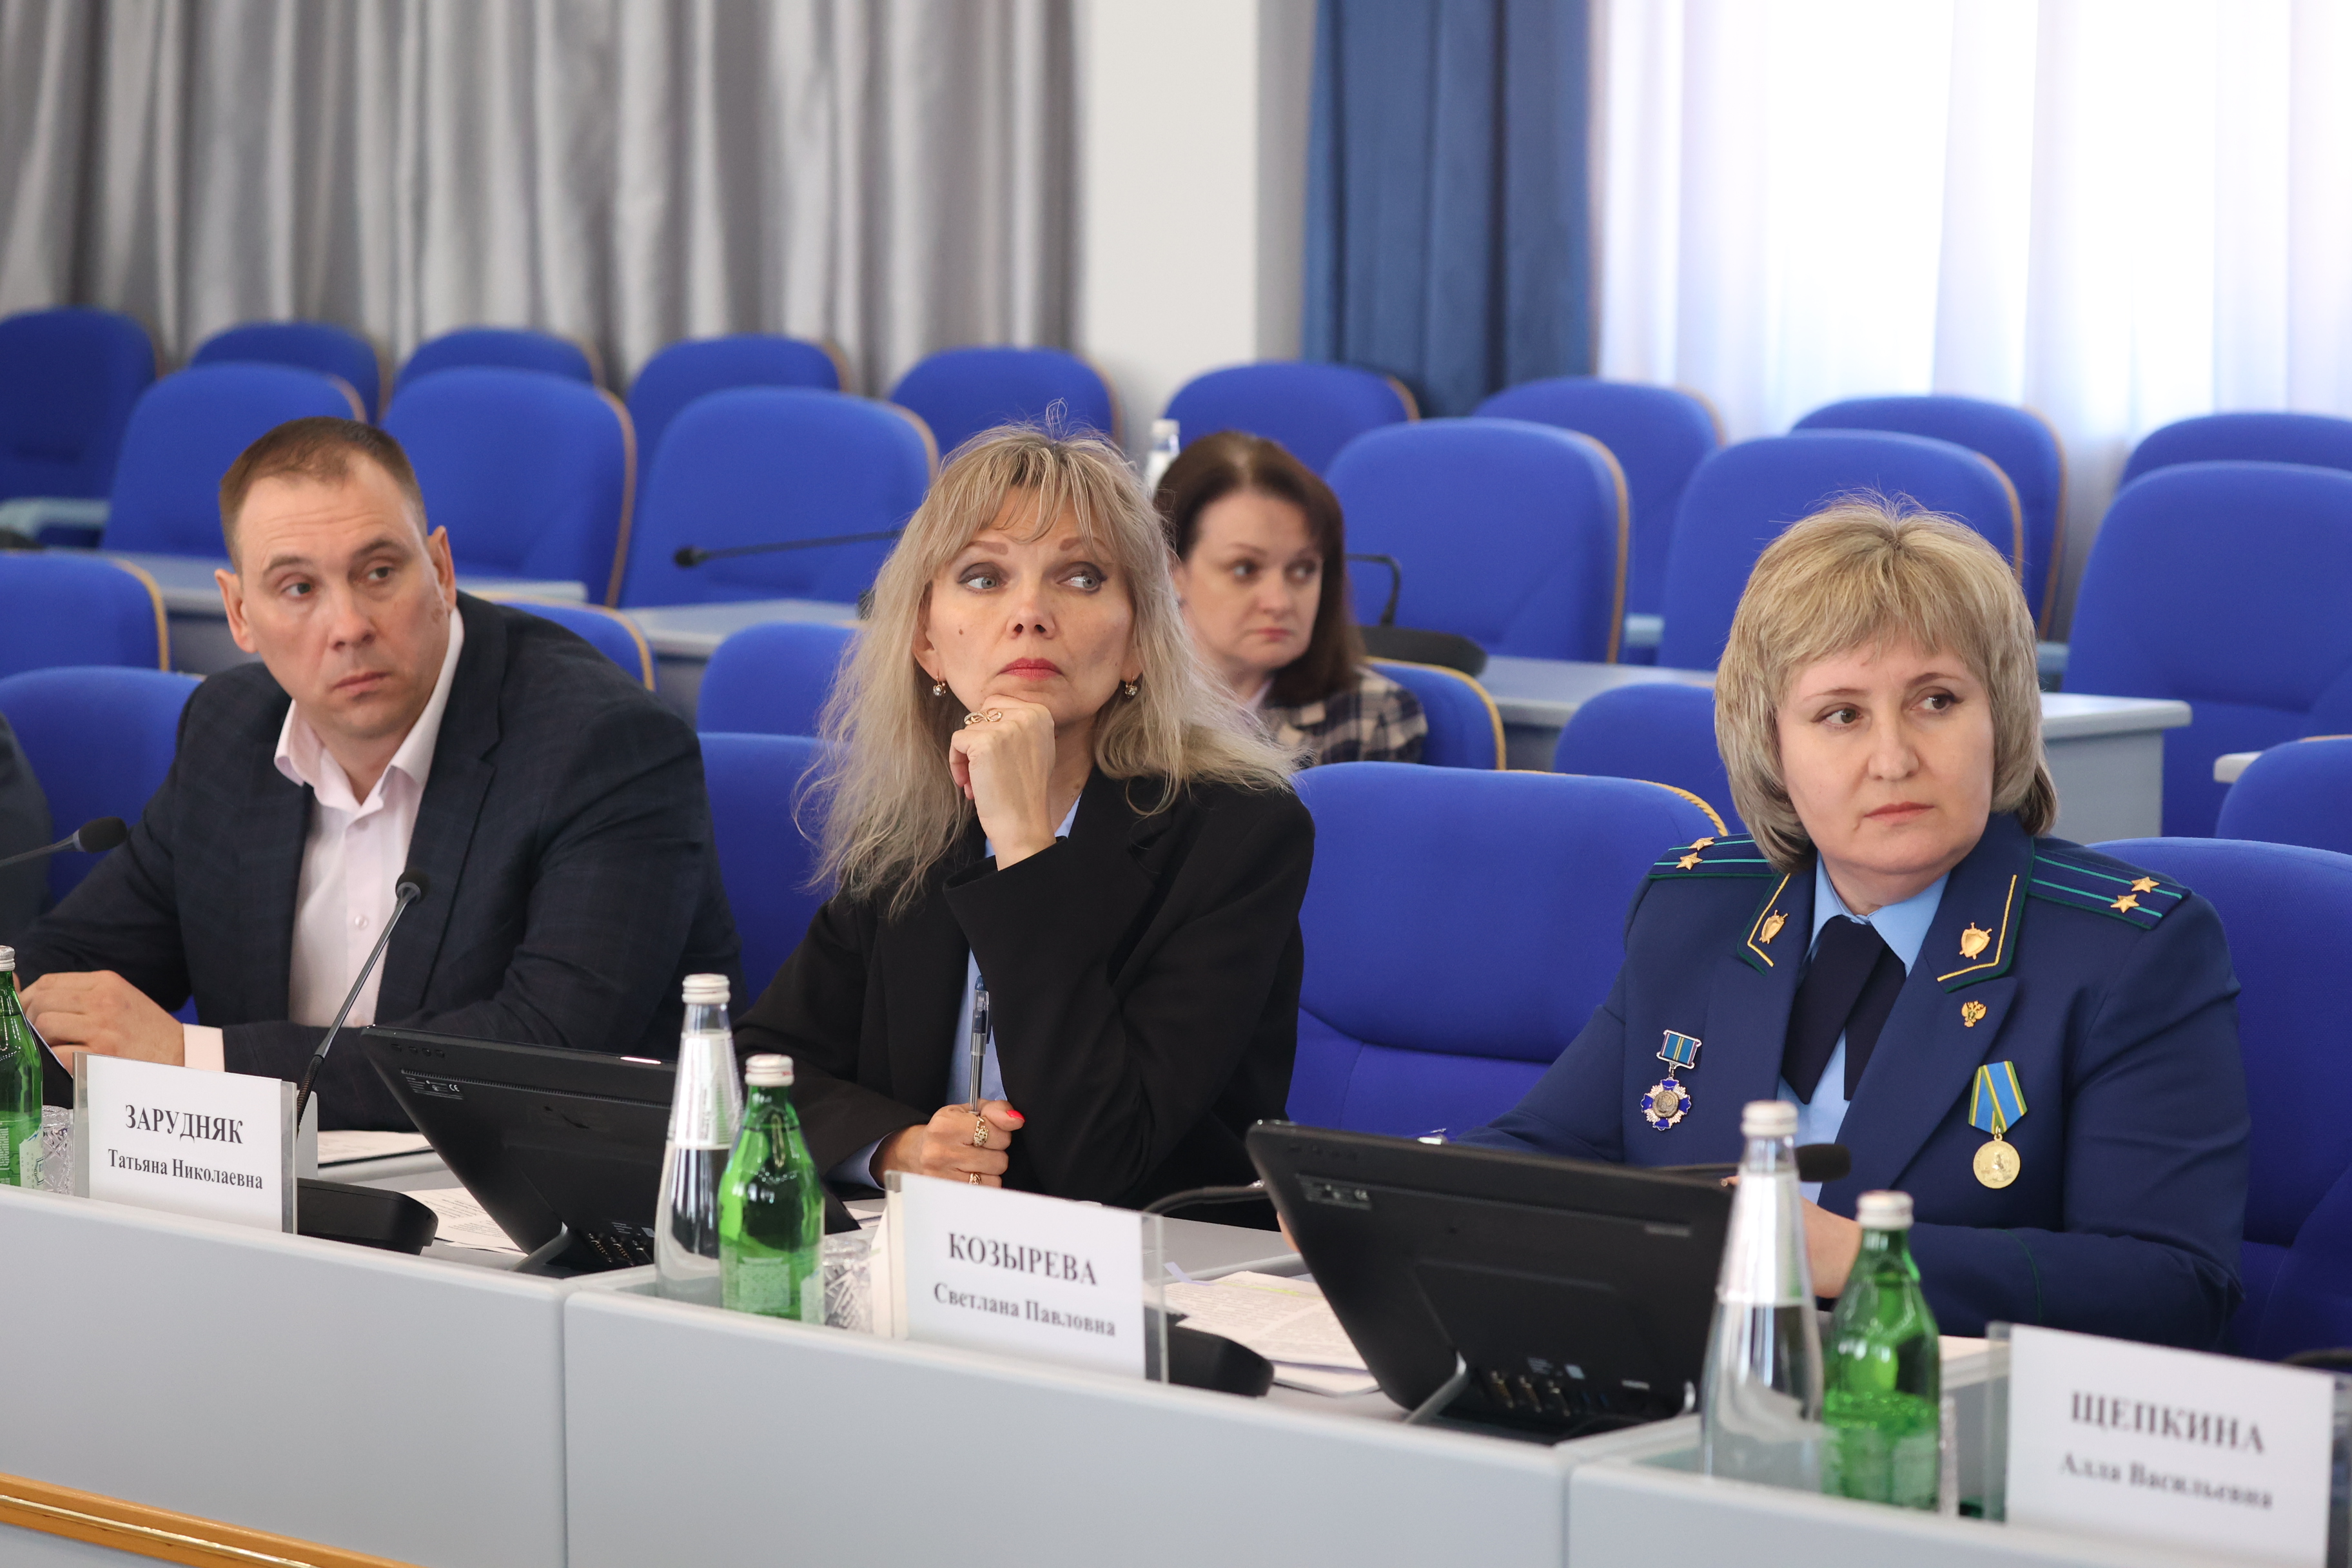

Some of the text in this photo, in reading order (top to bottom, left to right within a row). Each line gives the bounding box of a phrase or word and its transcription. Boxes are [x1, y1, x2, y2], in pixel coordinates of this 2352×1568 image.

[125, 1104, 244, 1144] ЗАРУДНЯК
[108, 1148, 264, 1190] Татьяна Николаевна
[948, 1231, 1097, 1286] КОЗЫРЕВА
[934, 1282, 1019, 1318] Светлана
[1024, 1298, 1116, 1337] Павловна
[2071, 1391, 2264, 1453] ЩЕПКИНА
[2060, 1453, 2120, 1480] Алла
